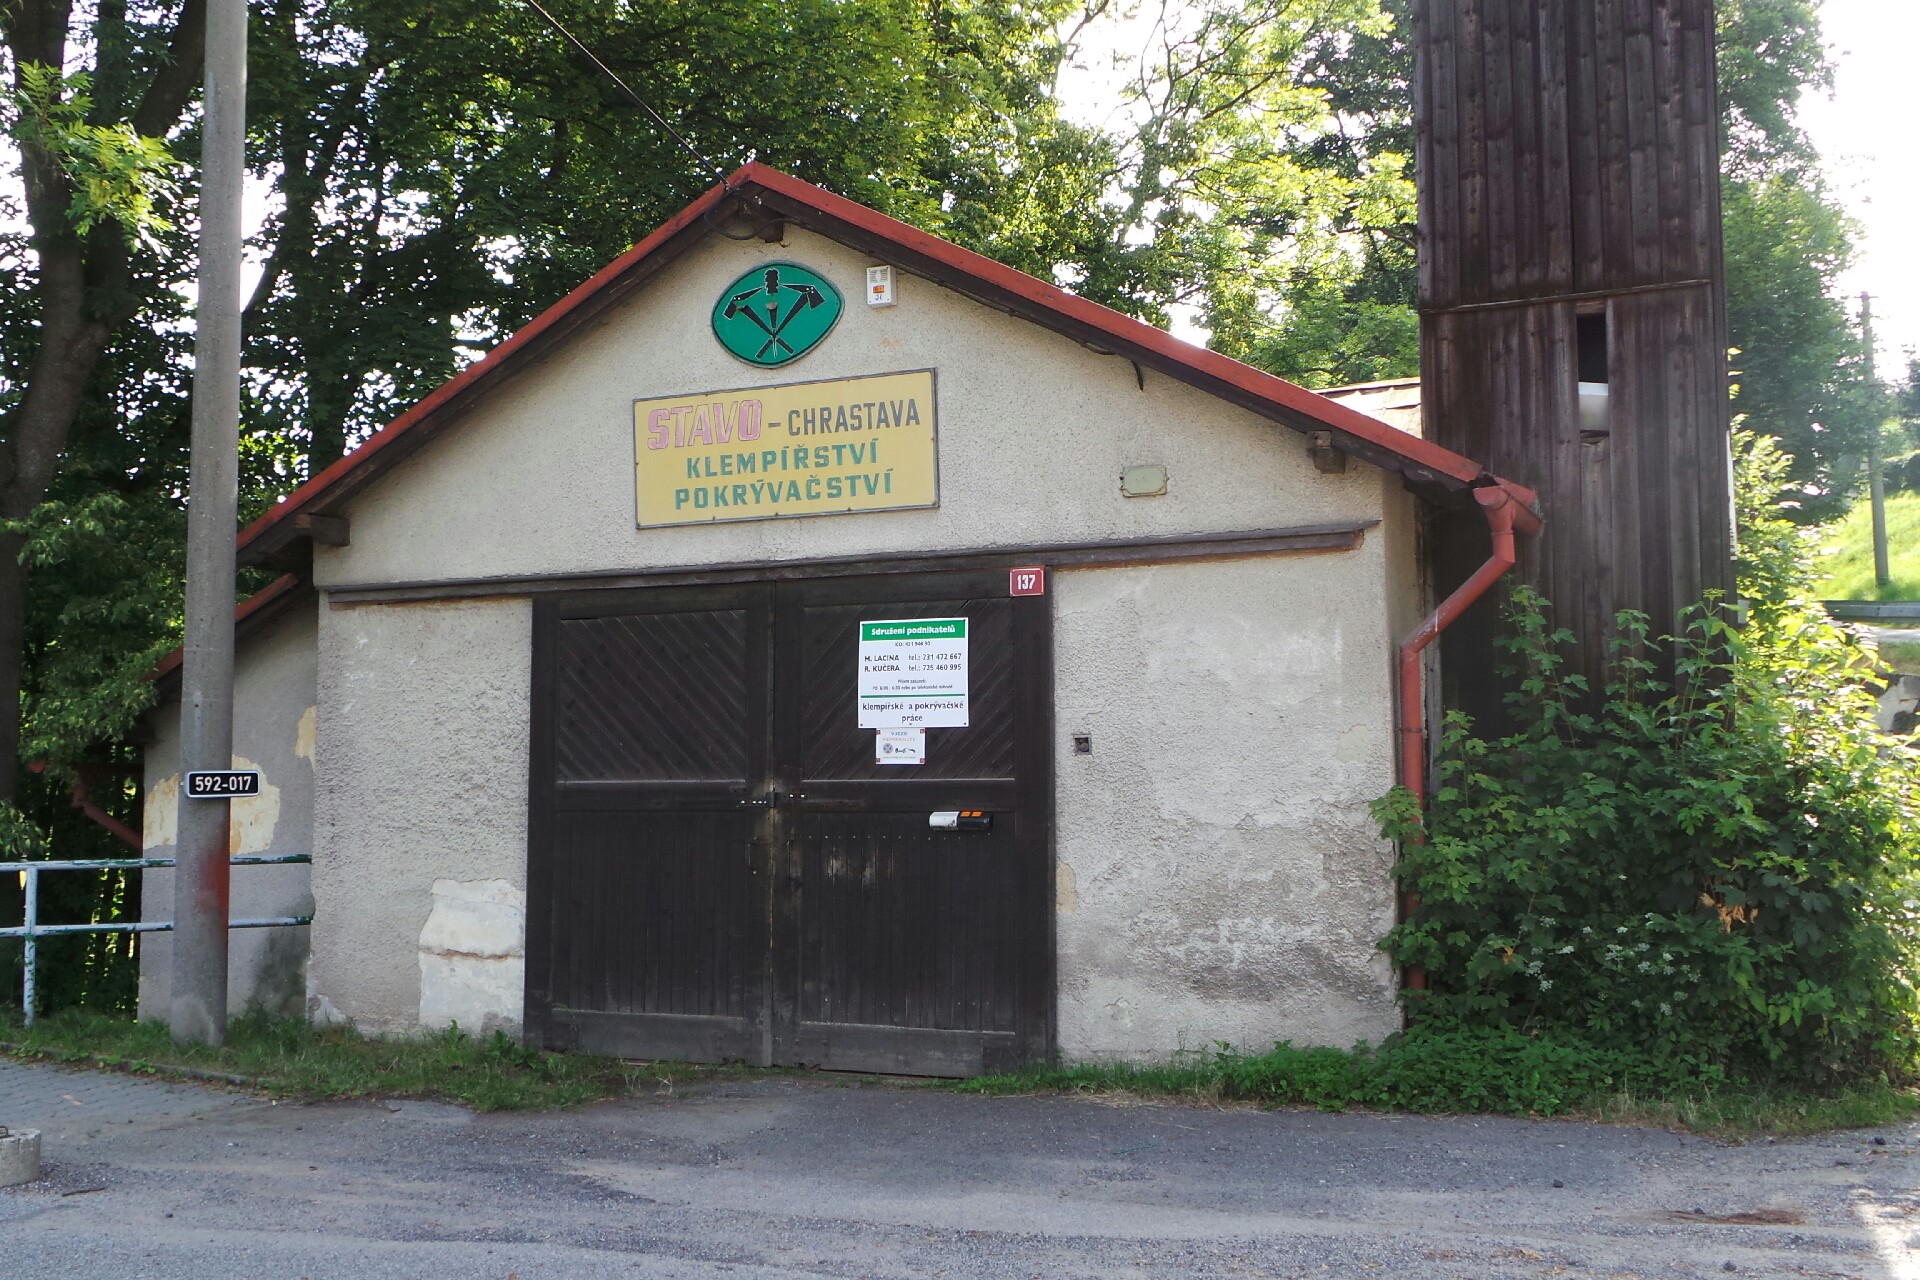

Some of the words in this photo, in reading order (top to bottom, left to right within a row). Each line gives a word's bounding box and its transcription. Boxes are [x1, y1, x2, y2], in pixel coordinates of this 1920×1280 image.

[647, 398, 762, 450] STAVO
[788, 398, 920, 436] CHRASTAVA
[687, 438, 878, 478] KLEMPÍŘSTVÍ
[675, 468, 893, 510] POKRÝVAČSTVÍ
[1017, 574, 1036, 590] 137
[871, 626, 906, 636] Sdružení
[907, 624, 955, 636] podnikatelů
[874, 654, 900, 662] LACINA
[872, 664, 900, 672] KUČERA
[862, 702, 904, 712] klempířské
[914, 700, 964, 712] pokrývačské
[901, 714, 923, 723] práce
[195, 775, 252, 792] 592-017
